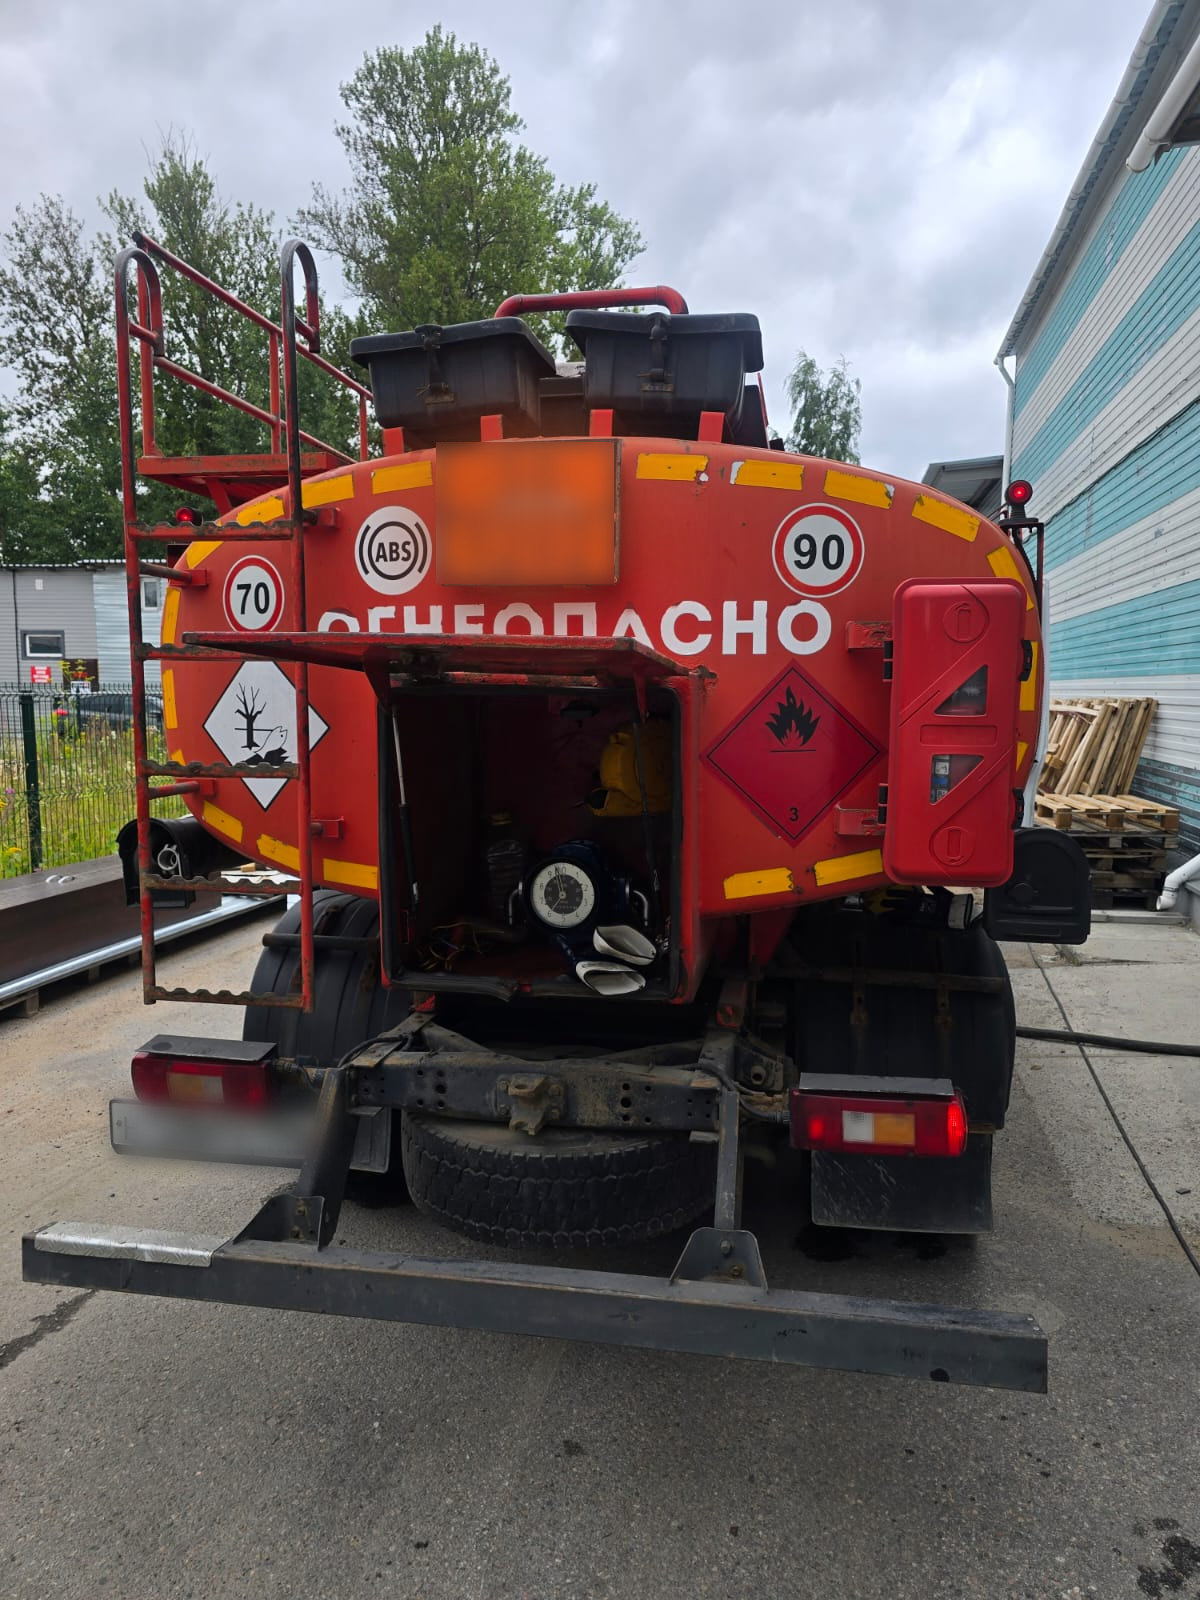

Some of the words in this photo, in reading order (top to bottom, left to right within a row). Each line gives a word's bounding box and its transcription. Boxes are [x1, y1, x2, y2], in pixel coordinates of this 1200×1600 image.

[375, 540, 412, 563] ABS
[793, 533, 845, 570] 90
[236, 581, 270, 615] 70
[789, 806, 799, 822] 3
